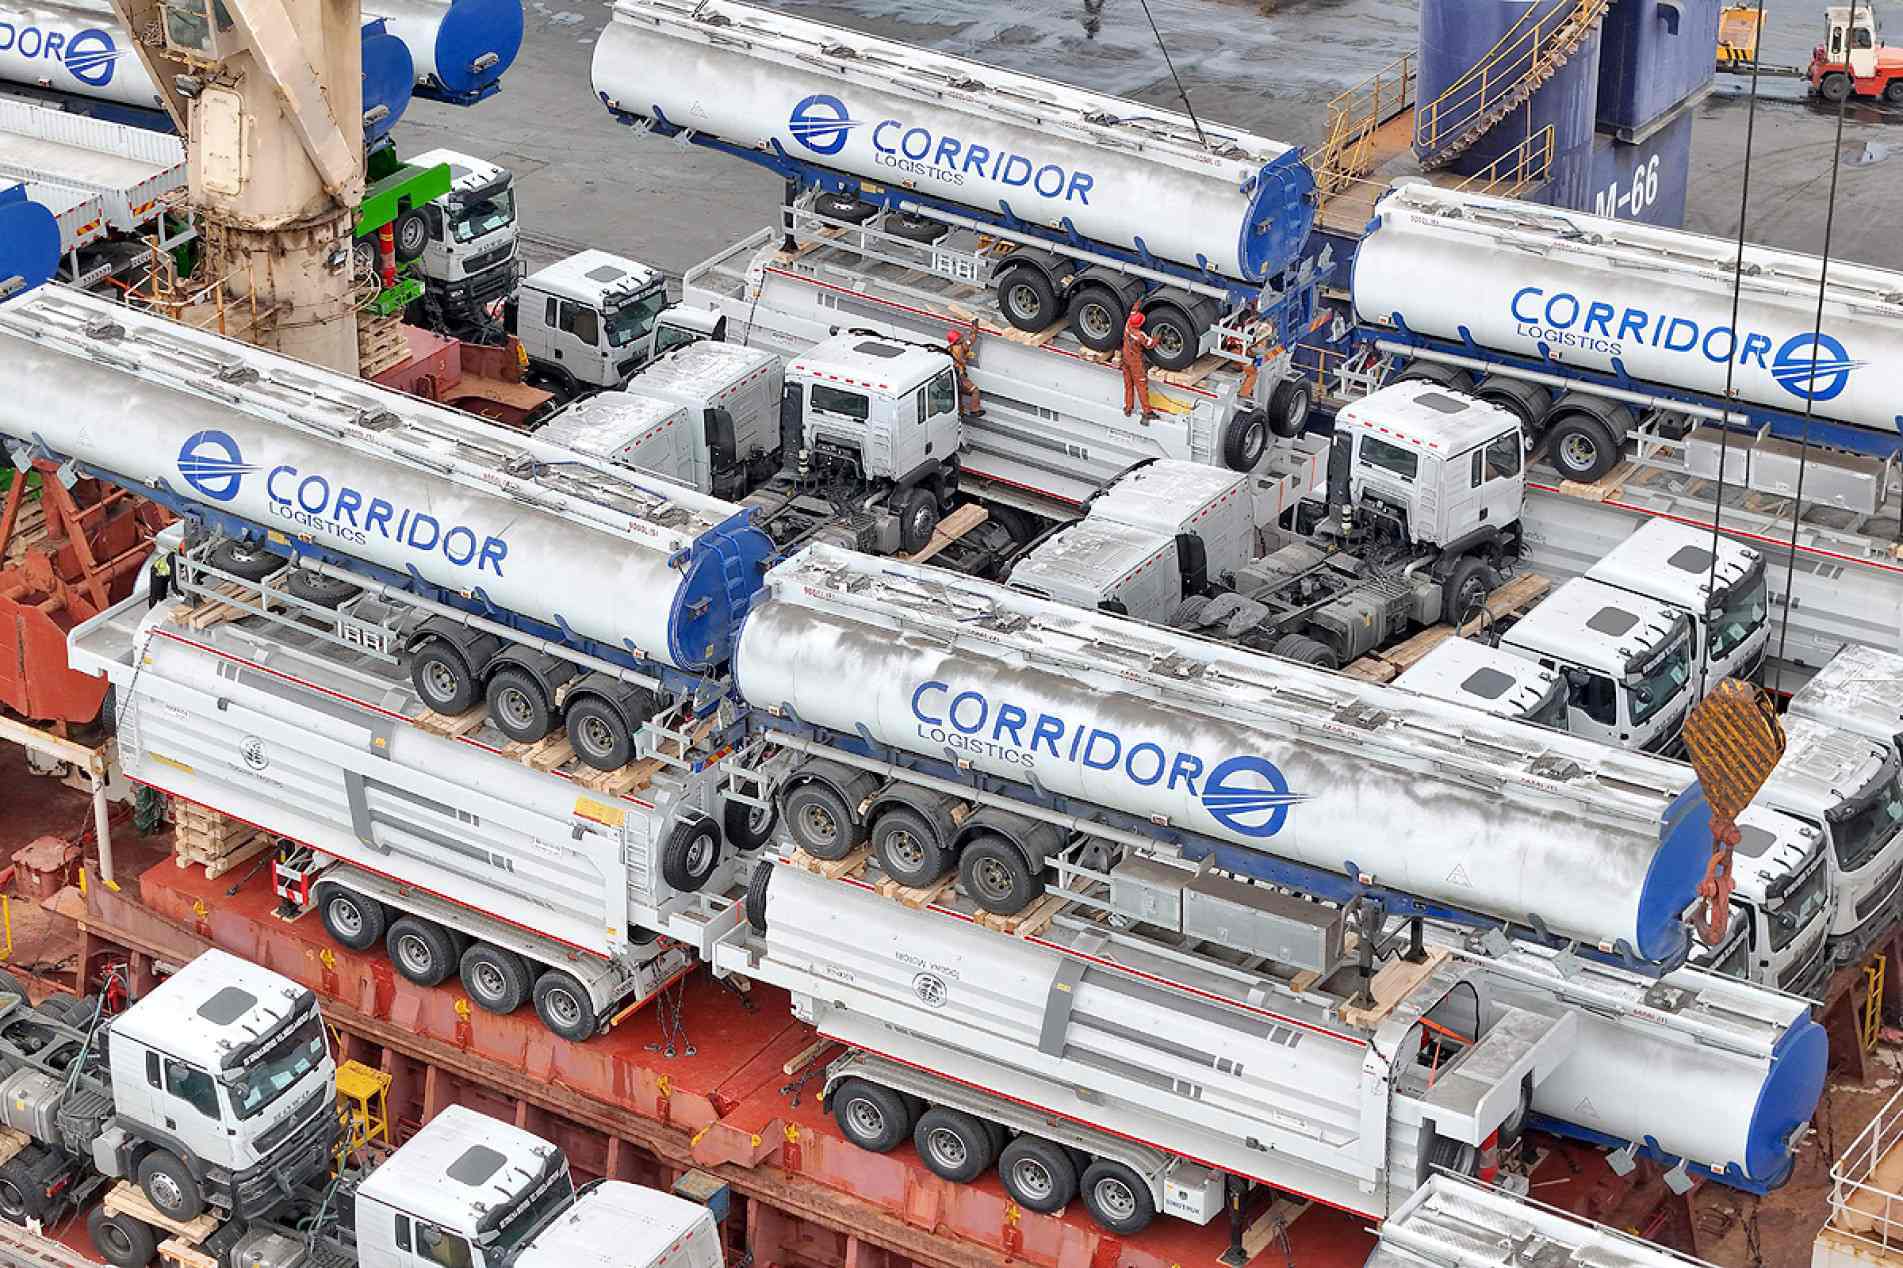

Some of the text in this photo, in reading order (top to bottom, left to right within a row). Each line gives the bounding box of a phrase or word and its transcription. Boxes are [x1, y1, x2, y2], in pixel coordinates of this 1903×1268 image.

[872, 119, 1094, 205] CORRIDOR
[874, 152, 964, 186] LOGISTICS
[1511, 286, 1773, 369] CORRIDOR
[1517, 323, 1622, 356] LOGISTICS
[267, 465, 508, 577] CORRIDOR
[269, 501, 366, 545] LOGISTICS
[911, 680, 1203, 796] CORRIDOR
[917, 723, 1035, 768] LOGISTICS
